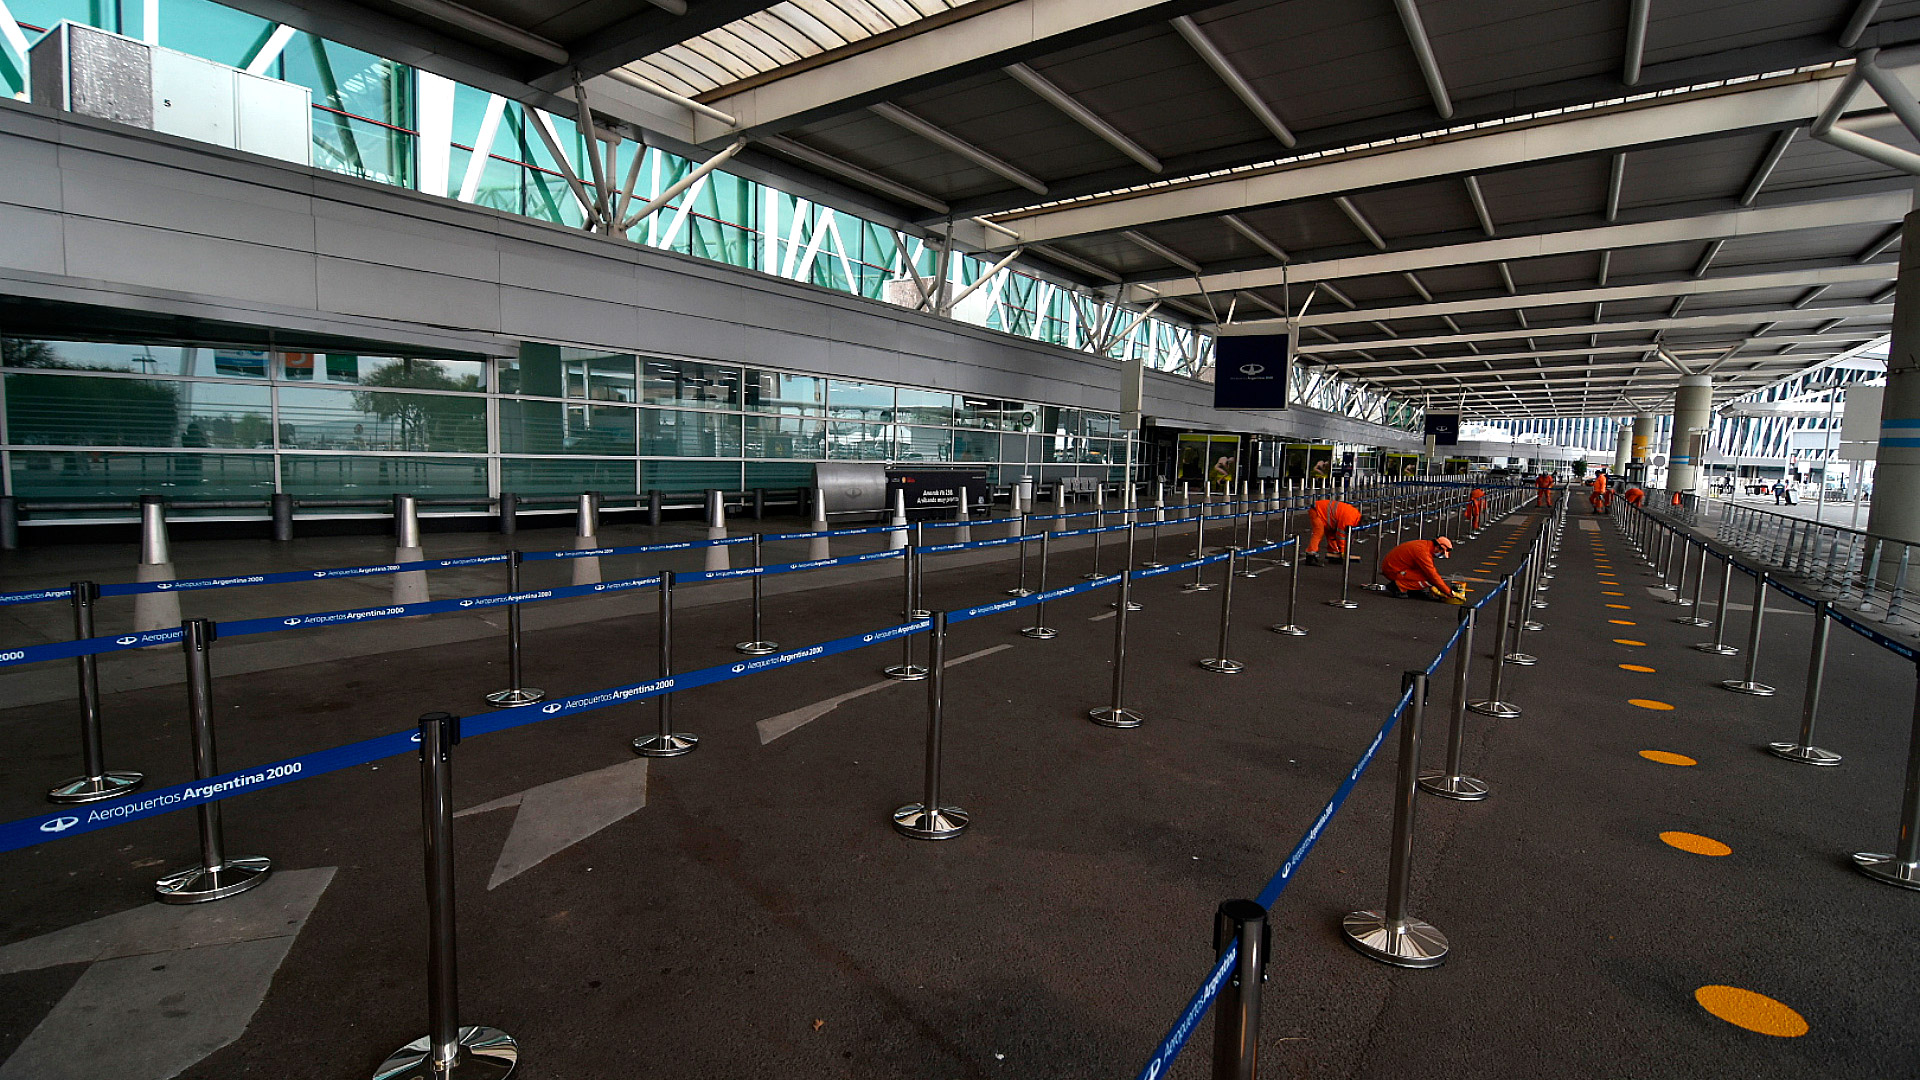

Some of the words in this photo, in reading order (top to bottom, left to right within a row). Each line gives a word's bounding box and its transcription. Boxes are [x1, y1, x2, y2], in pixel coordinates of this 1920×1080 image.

[164, 98, 172, 108] 5
[358, 564, 387, 574] Argentina
[174, 579, 212, 588] Aeropuertos
[211, 577, 248, 586] Argentina
[44, 589, 72, 599] Argen
[508, 592, 538, 603] Argentina
[304, 614, 347, 625] Aeropuertos
[346, 608, 386, 621] Argentina
[385, 606, 405, 615] 2000
[141, 629, 184, 644] Aeropuer
[779, 649, 810, 665] Argentina
[565, 693, 613, 711] Aeropuertos
[612, 684, 655, 701] Argentina
[654, 678, 675, 692] 2000
[87, 793, 181, 823] Aeropuertos
[183, 775, 264, 800] Argentina
[266, 762, 302, 781] 2000
